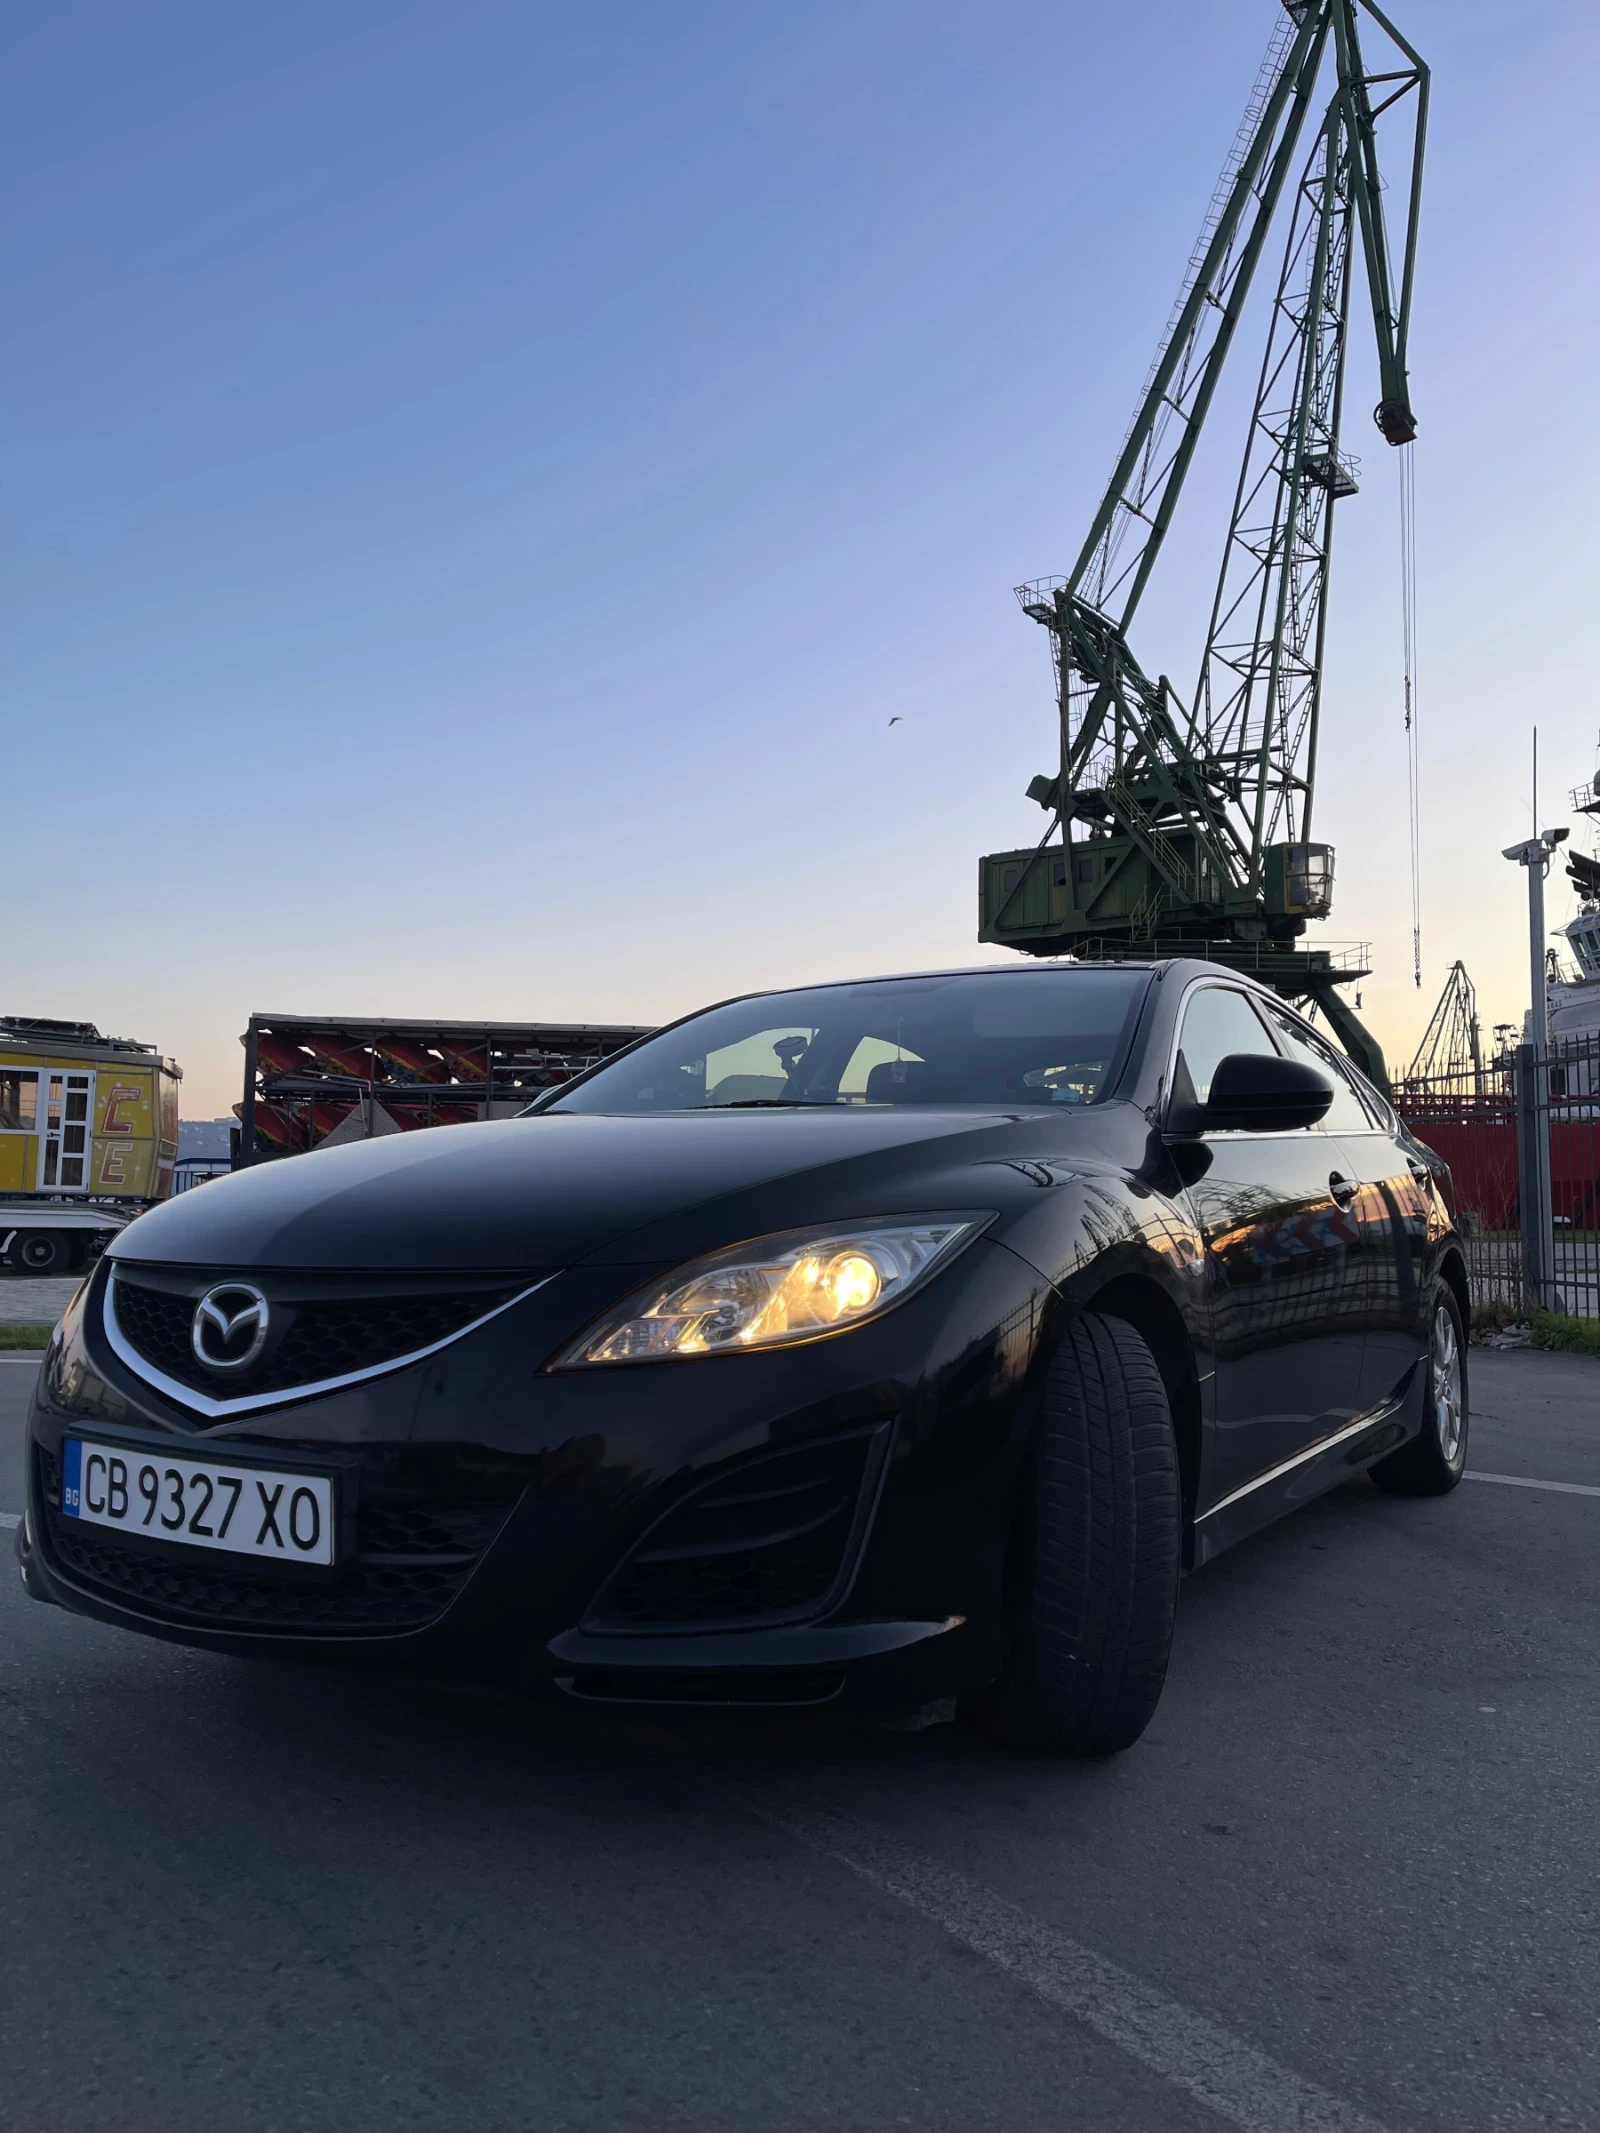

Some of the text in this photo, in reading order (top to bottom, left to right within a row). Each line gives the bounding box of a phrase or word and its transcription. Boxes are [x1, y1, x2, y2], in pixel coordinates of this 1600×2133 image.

[65, 1487, 79, 1507] BG
[85, 1453, 320, 1551] CB 9327 XO
